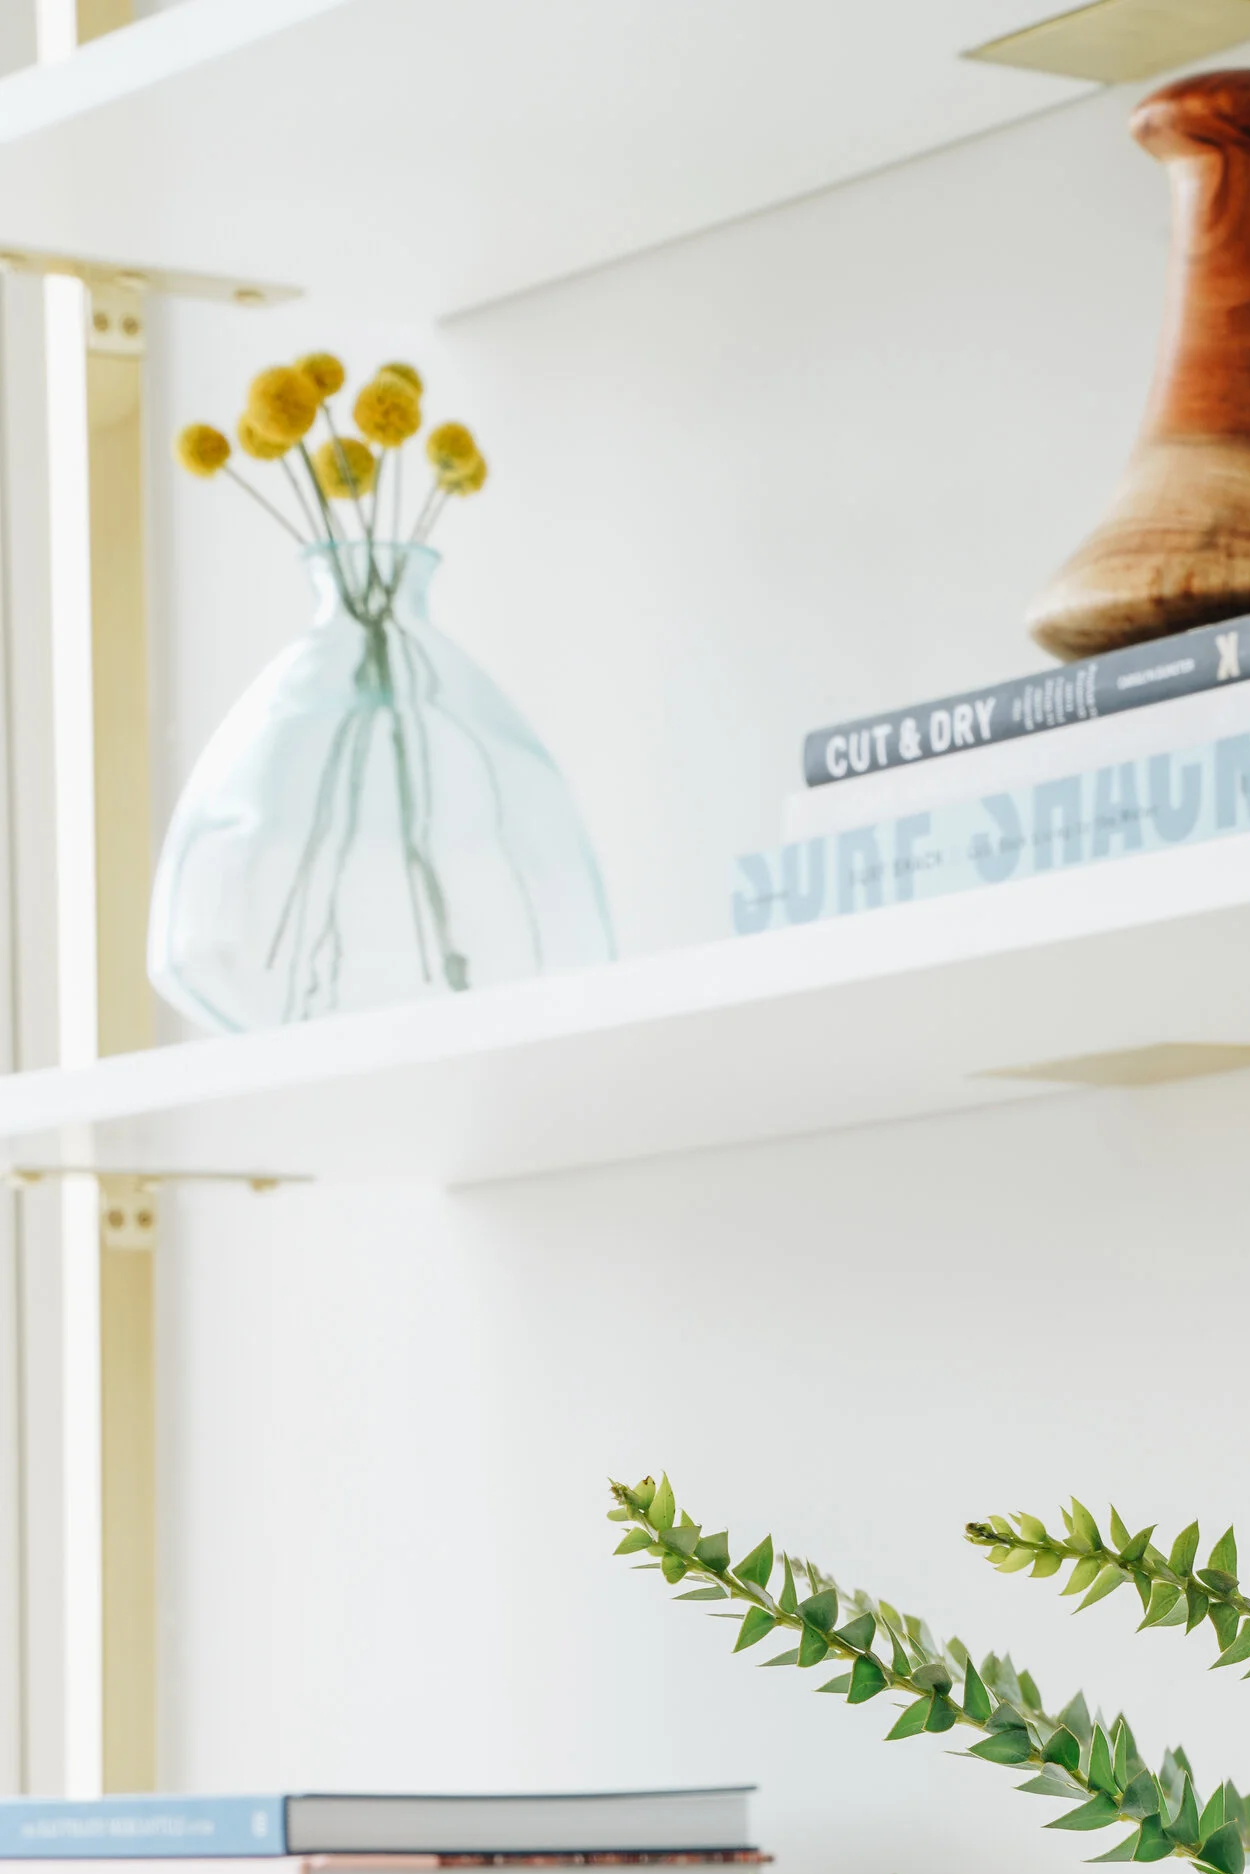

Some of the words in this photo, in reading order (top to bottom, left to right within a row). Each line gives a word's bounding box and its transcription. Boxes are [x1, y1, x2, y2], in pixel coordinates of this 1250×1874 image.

[826, 723, 893, 779] CUT
[898, 717, 923, 761] &
[929, 696, 997, 753] DRY
